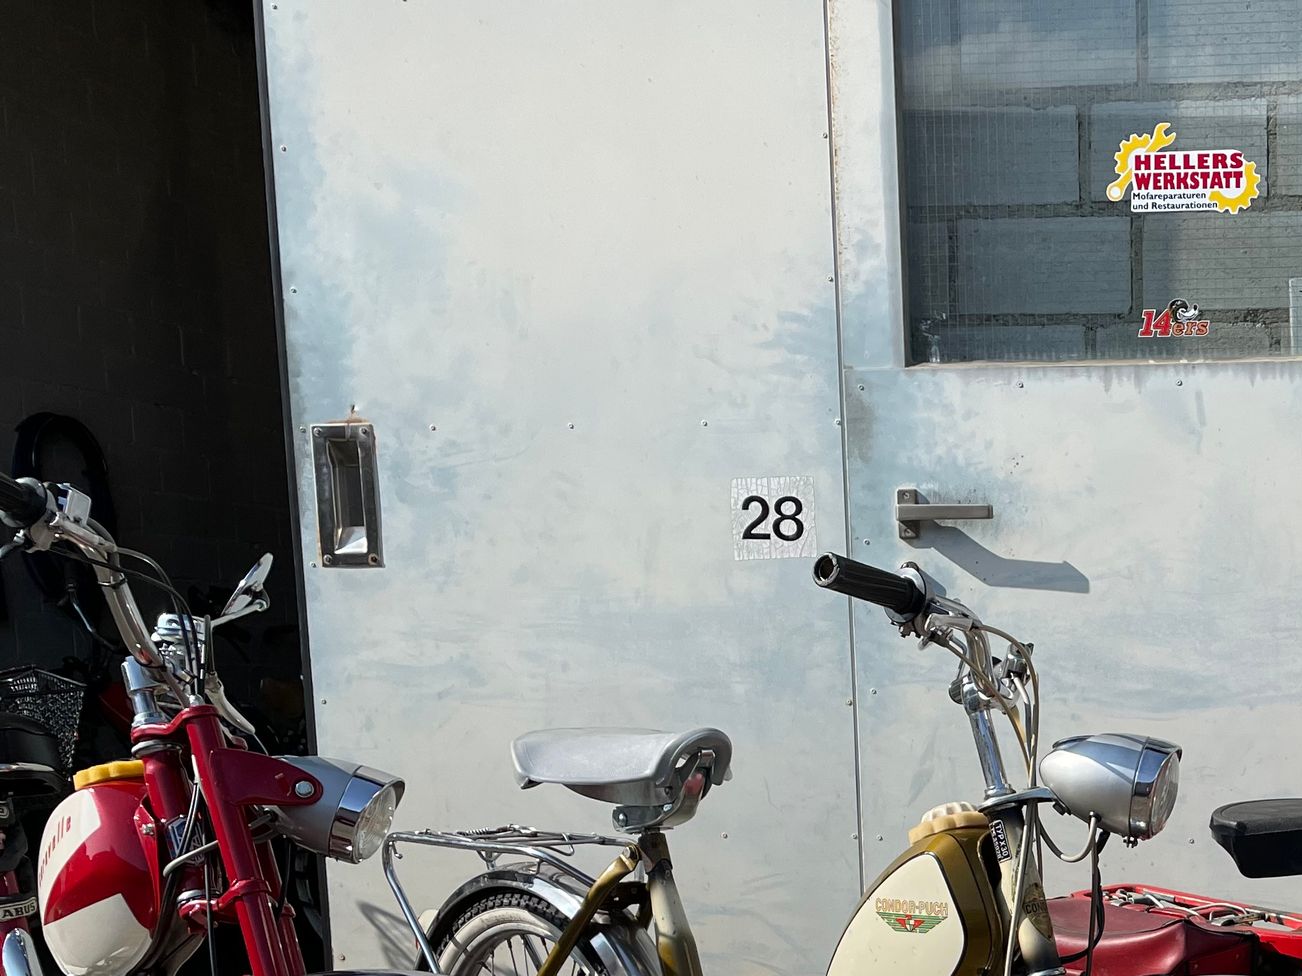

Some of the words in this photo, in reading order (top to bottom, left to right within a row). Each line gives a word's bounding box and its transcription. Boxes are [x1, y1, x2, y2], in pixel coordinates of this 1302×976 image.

[1134, 153, 1244, 171] HELLERS
[1134, 171, 1244, 190] WERKSTATT
[1132, 191, 1207, 202] Mofareparaturen
[1132, 201, 1149, 210] und
[1151, 200, 1218, 210] Restaurationen
[1138, 309, 1209, 337] 14ers
[741, 495, 804, 542] 28
[2, 901, 36, 919] ABUS
